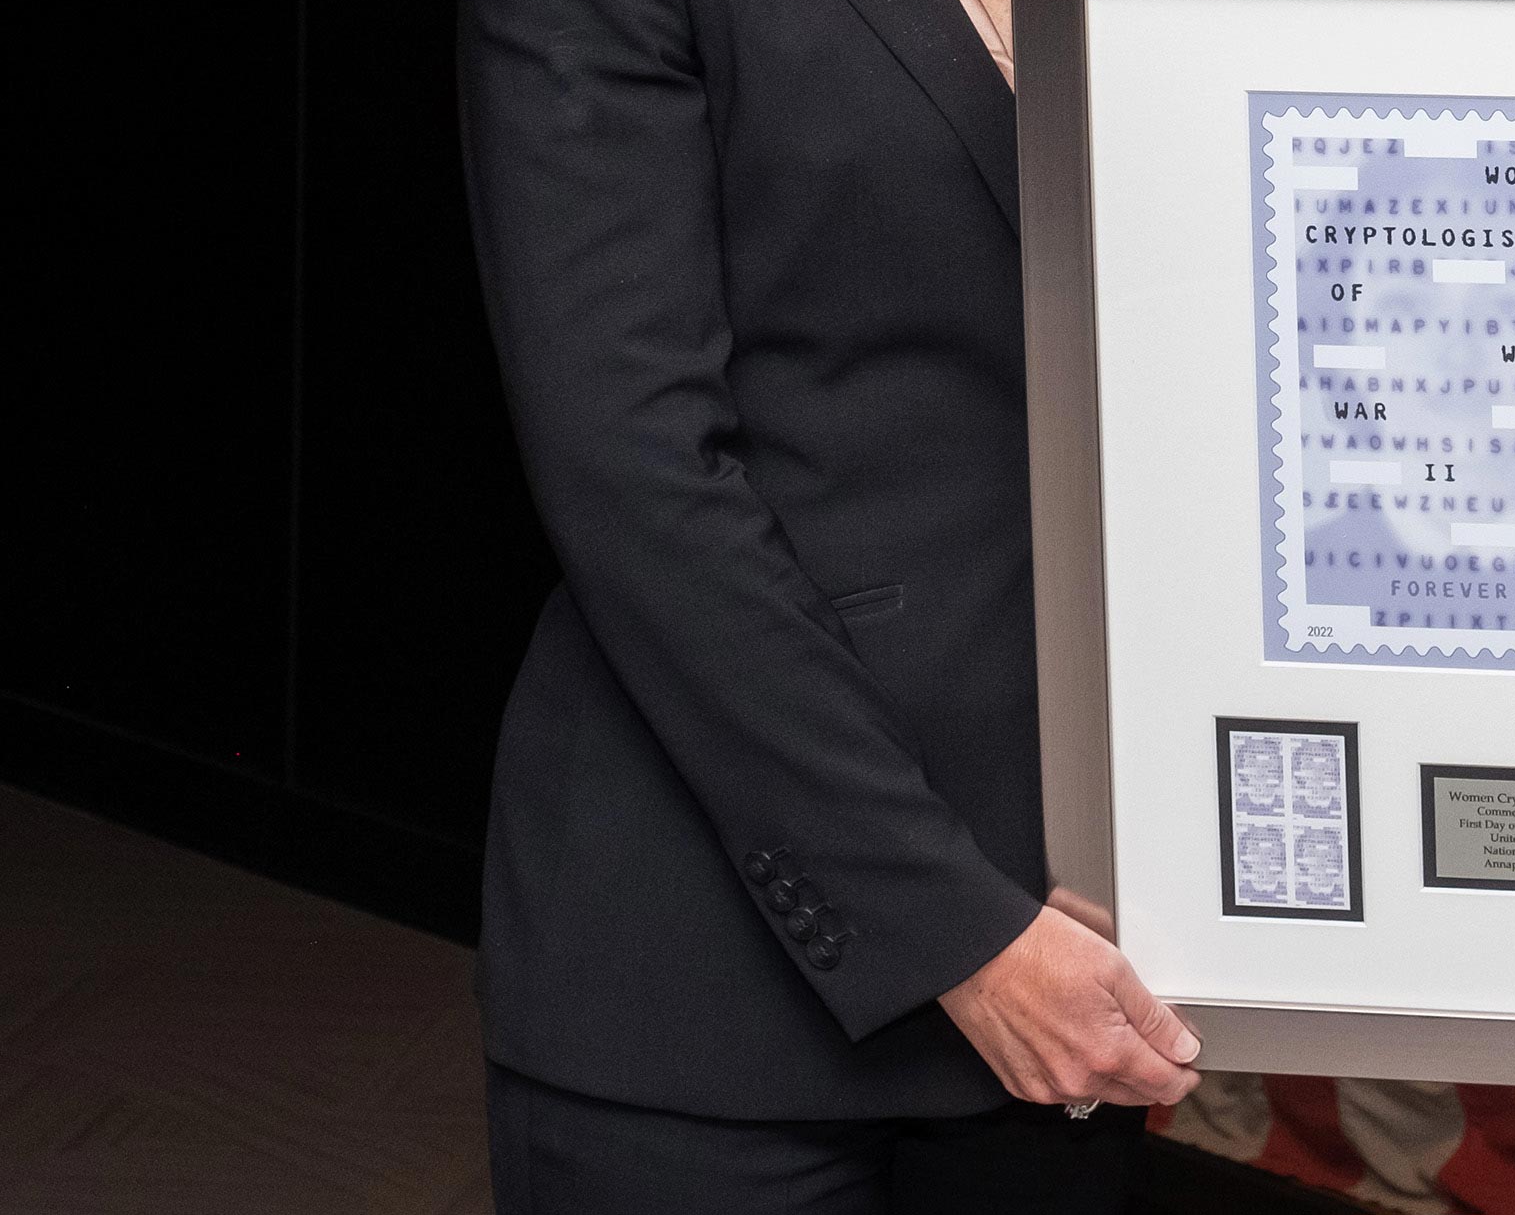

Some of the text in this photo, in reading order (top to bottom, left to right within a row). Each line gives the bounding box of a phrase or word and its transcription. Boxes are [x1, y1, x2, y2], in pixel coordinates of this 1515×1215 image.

[1331, 283, 1364, 302] OF
[1334, 401, 1387, 420] WAR
[1425, 464, 1456, 482] II
[1391, 580, 1508, 599] FOREVER
[1307, 625, 1334, 637] 2022
[1449, 791, 1494, 803] Women
[1459, 818, 1482, 829] First
[1485, 819, 1505, 833] Day
